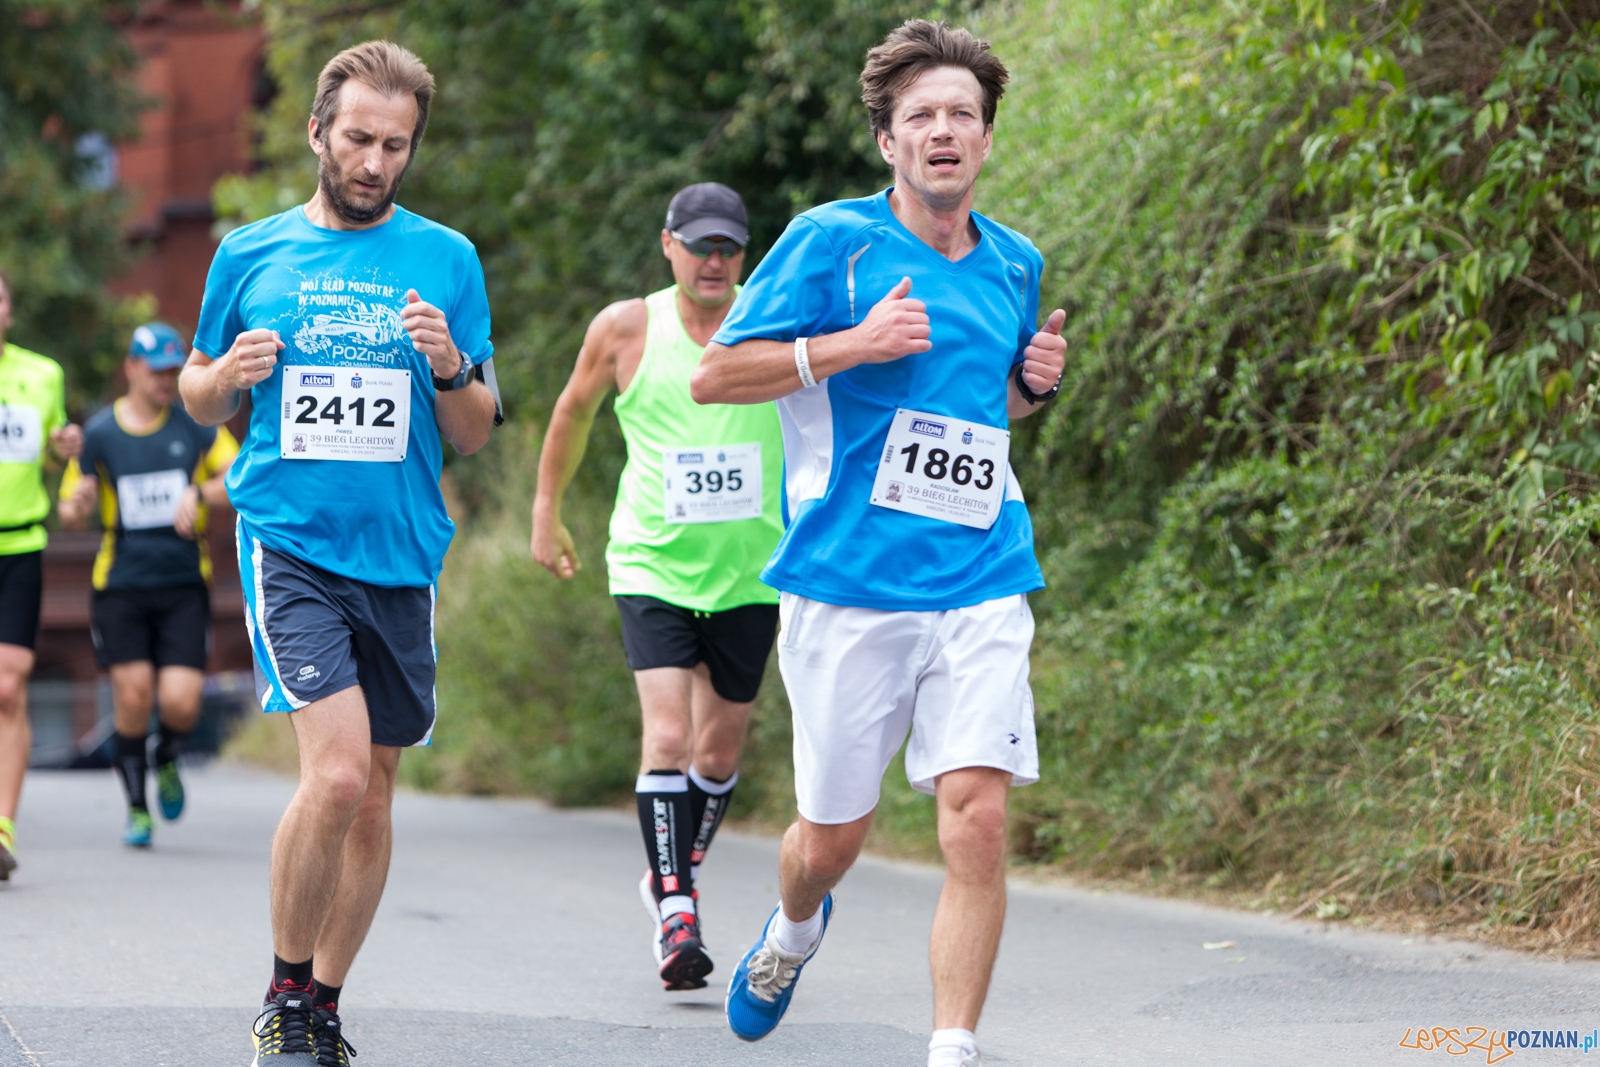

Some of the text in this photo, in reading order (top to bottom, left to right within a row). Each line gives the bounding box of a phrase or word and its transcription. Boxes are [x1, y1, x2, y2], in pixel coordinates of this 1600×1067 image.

[348, 281, 394, 298] POZOSTAŁ
[298, 294, 354, 306] W POZNANIU
[295, 396, 396, 428] 2412
[310, 434, 396, 445] 39 BIEG LECHITÓW
[900, 442, 995, 490] 1863
[686, 468, 742, 494] 395
[930, 483, 960, 494] RADOSŁAW
[906, 486, 920, 495] 39
[922, 488, 946, 500] BIEG
[948, 494, 992, 510] LECHITÓW
[286, 1000, 302, 1008] NIKE
